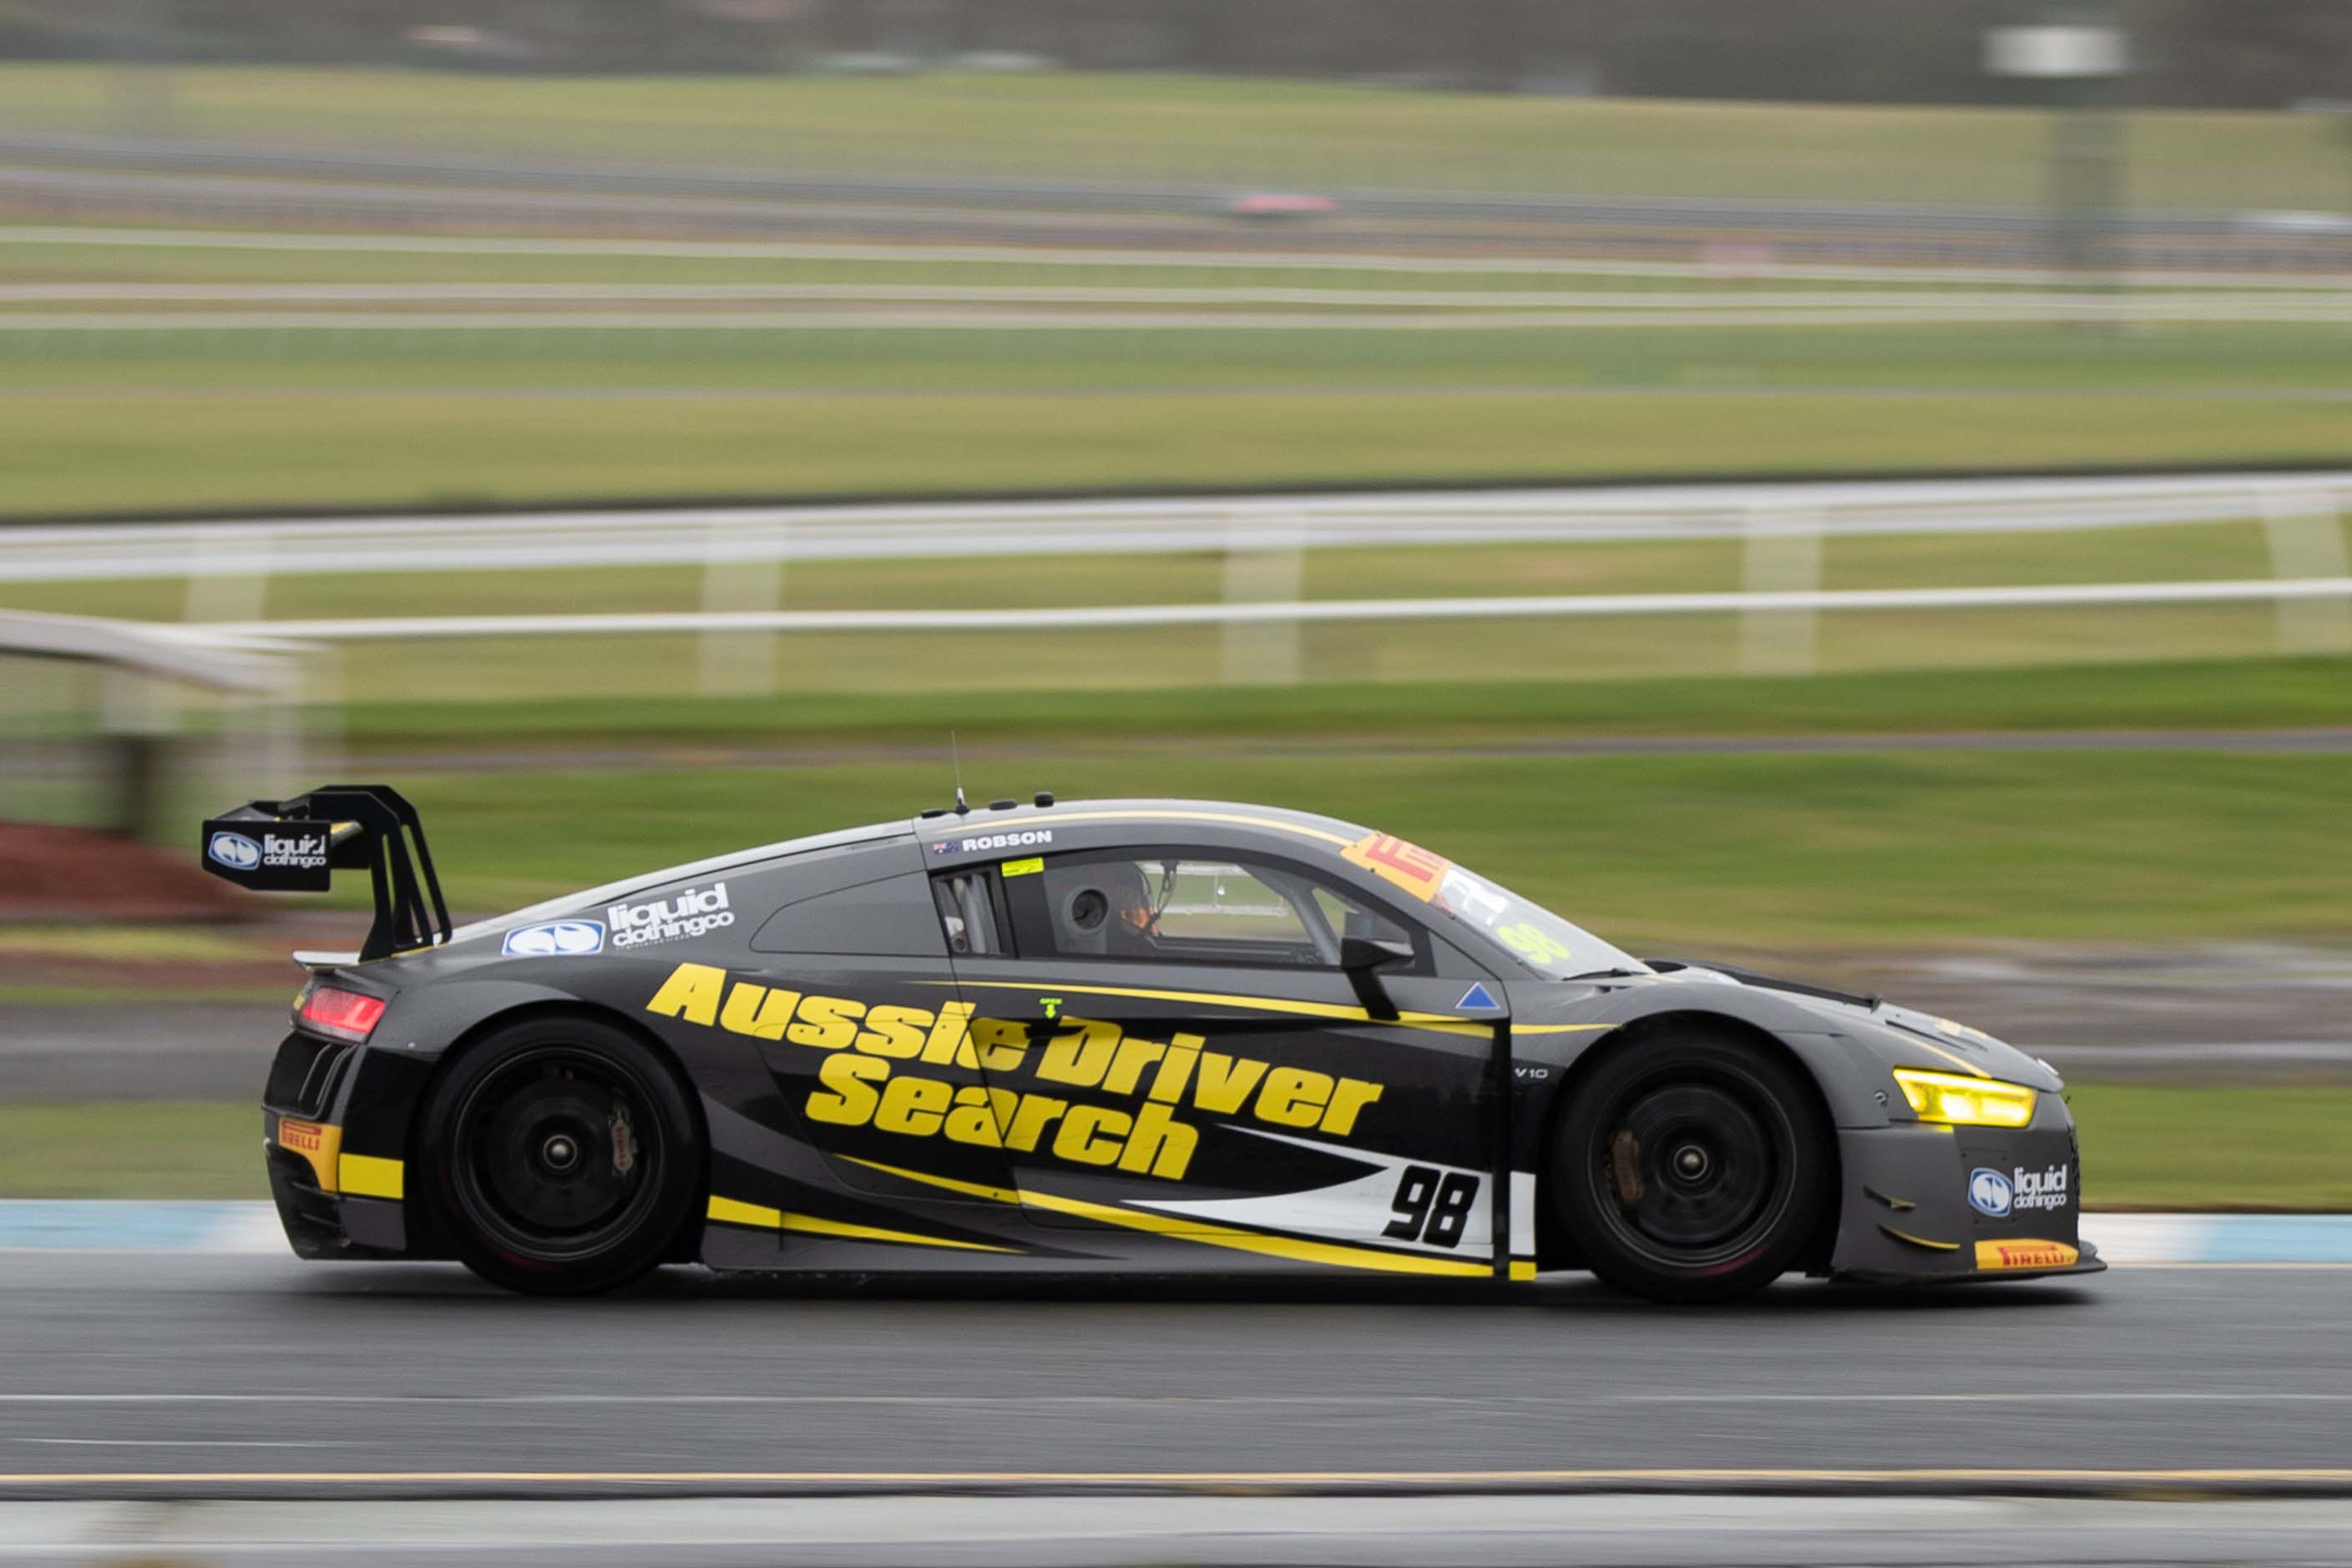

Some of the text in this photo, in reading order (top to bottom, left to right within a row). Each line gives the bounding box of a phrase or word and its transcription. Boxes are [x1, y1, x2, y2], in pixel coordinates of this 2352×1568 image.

[962, 830, 1053, 852] ROBSON
[607, 882, 730, 932] liquid
[612, 911, 735, 947] clothingco
[1496, 922, 1571, 964] 98
[645, 962, 1384, 1136] Aussie Driver
[1515, 1068, 1549, 1079] V10
[805, 1052, 1199, 1181] Search
[2014, 1164, 2067, 1194] liquid
[1380, 1164, 1480, 1249] 98
[1997, 1244, 2065, 1266] PIRELLI
